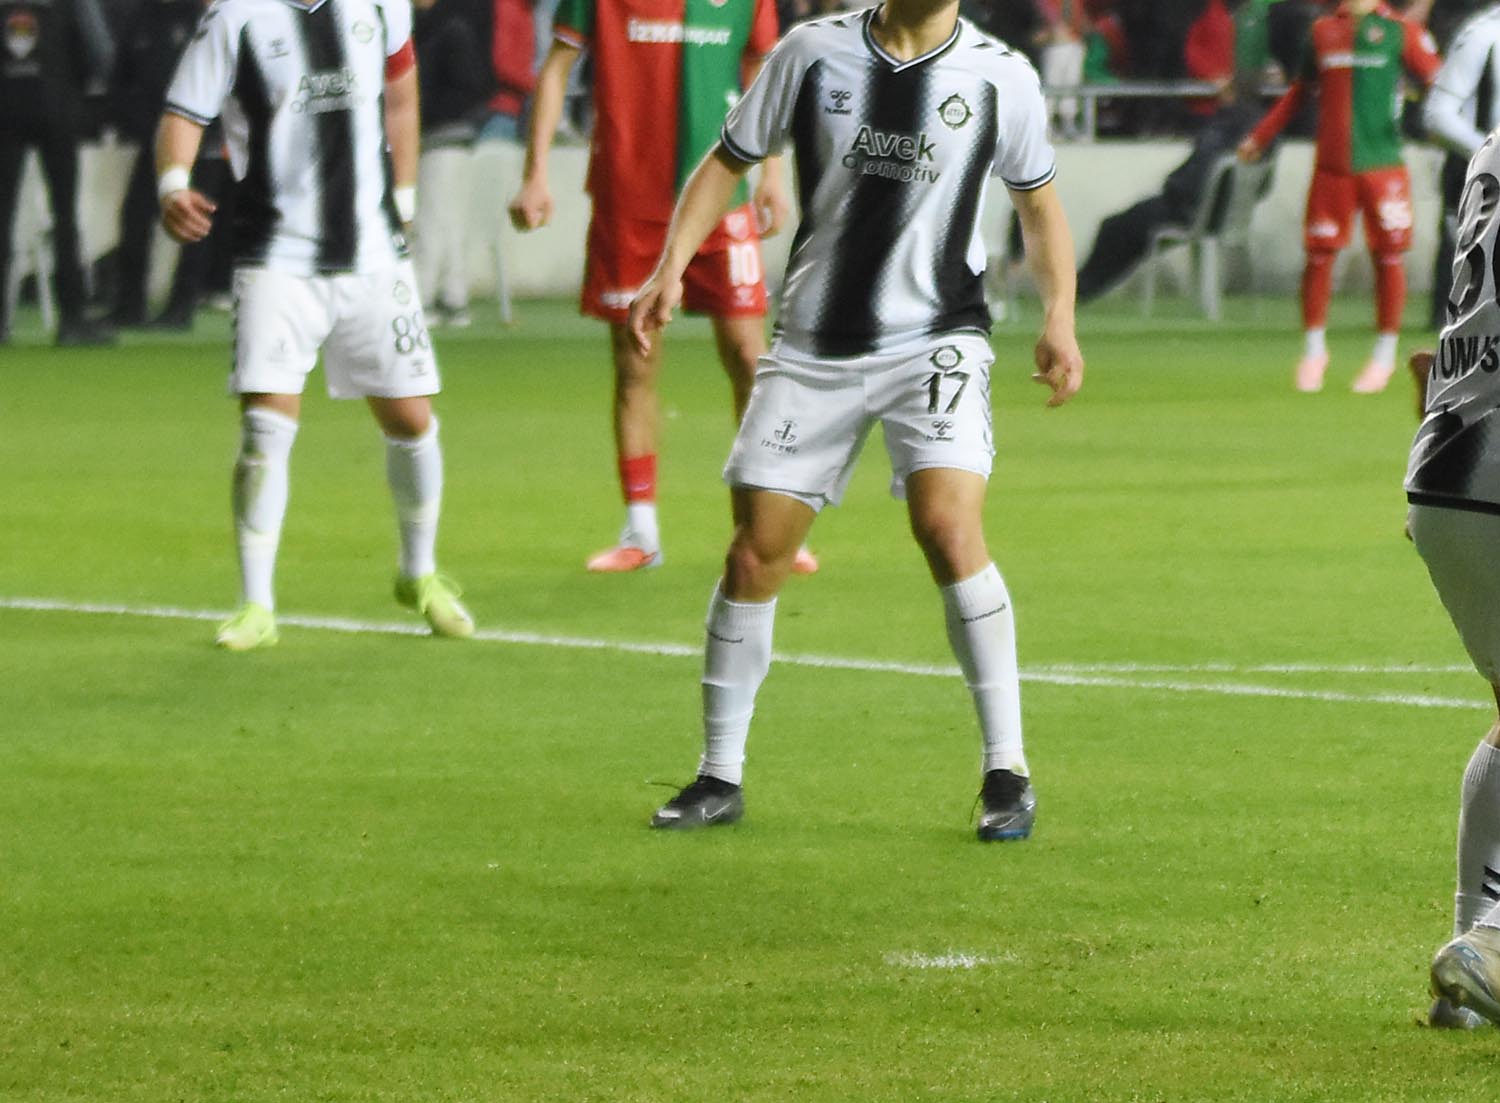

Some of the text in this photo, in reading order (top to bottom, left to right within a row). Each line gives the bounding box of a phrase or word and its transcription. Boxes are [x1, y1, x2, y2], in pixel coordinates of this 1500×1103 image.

[850, 124, 937, 162] Avek
[842, 154, 942, 184] Oomotiv
[729, 244, 761, 287] 10
[1432, 334, 1500, 381] UNUS
[921, 371, 971, 415] 17
